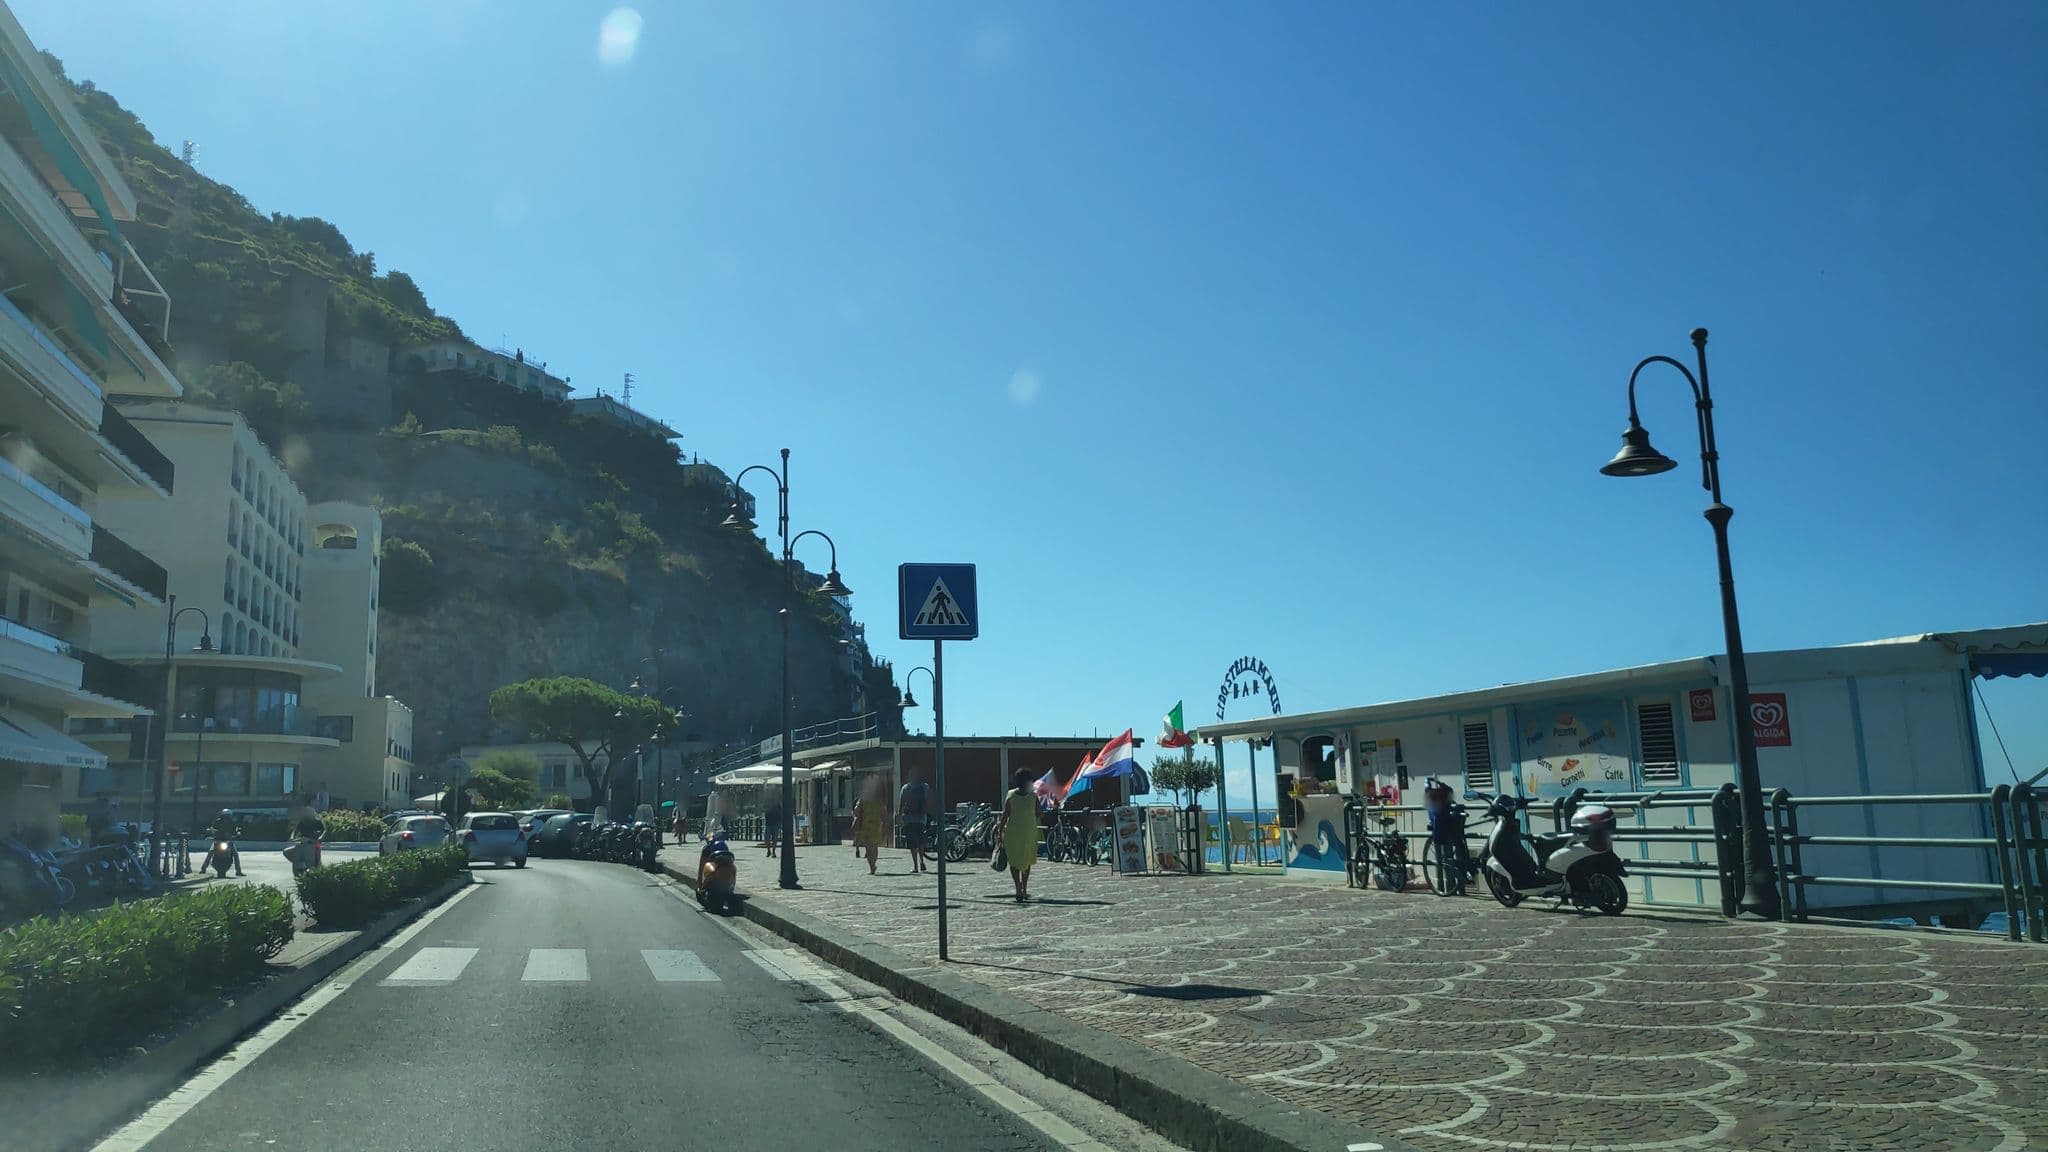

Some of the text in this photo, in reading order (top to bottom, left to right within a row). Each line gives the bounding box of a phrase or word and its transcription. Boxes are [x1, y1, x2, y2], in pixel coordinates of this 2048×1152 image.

[1216, 685, 1229, 720] LIDO
[1225, 656, 1257, 688] STELLA
[1233, 680, 1260, 699] BAR
[1753, 728, 1785, 738] ALGIDA
[1537, 756, 1553, 772] Birre
[1561, 768, 1586, 788] Cornetti
